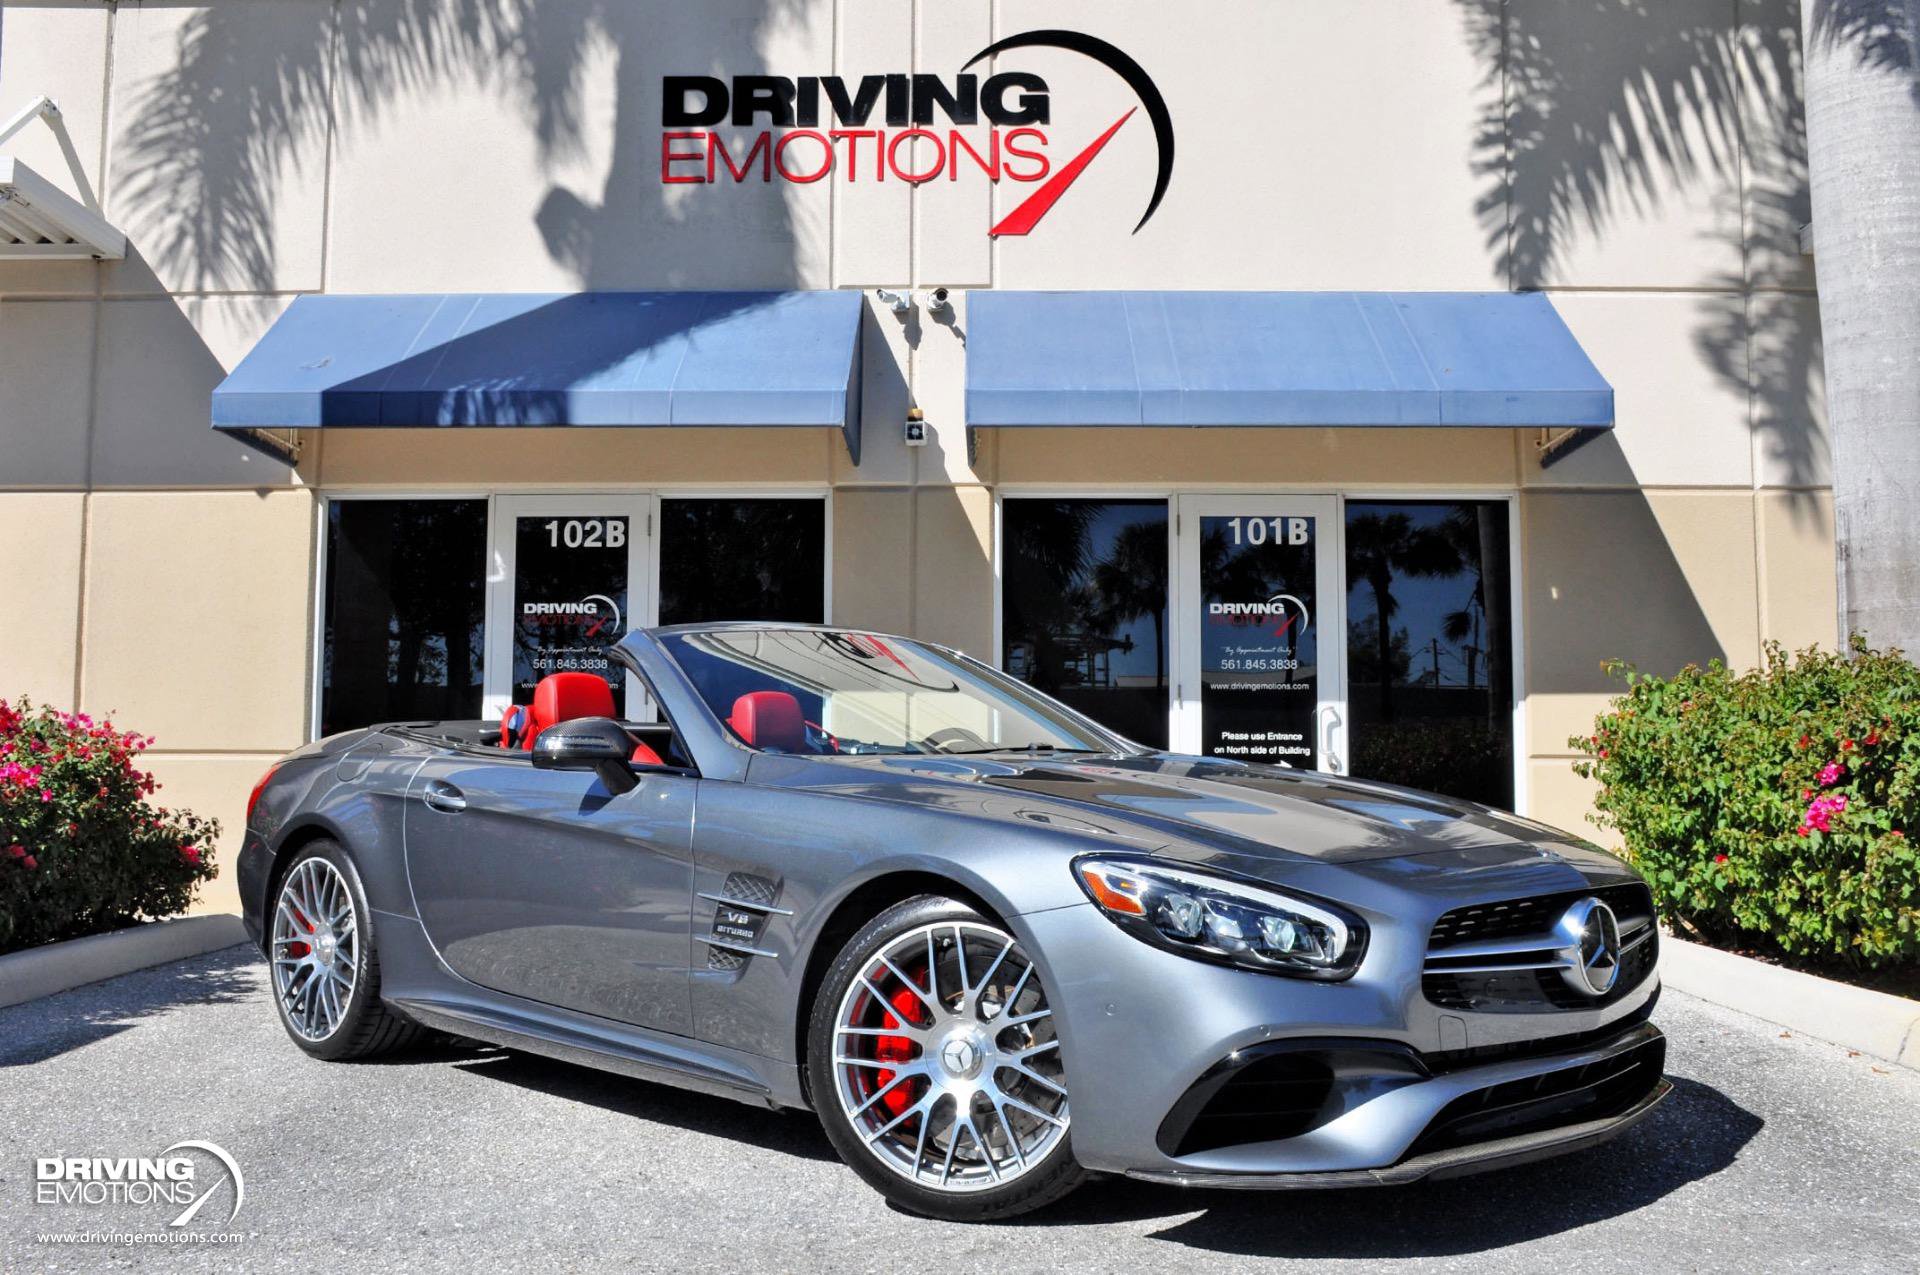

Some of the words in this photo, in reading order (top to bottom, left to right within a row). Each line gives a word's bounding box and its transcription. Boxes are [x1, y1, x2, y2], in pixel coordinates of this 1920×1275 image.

[662, 72, 1050, 127] DRIVING
[661, 128, 1050, 184] EMOTIONS
[545, 520, 625, 548] 102B
[1228, 517, 1308, 545] 101B
[523, 603, 598, 614] DRIVING
[1209, 603, 1285, 614] DRIVING
[533, 659, 608, 669] 561.845.3838
[1221, 659, 1298, 670] 561.845.3838
[1210, 683, 1310, 691] www.drivingemotions.com
[1221, 731, 1249, 741] Please
[1250, 733, 1266, 741] use
[1267, 731, 1303, 741] Entrance
[1214, 746, 1225, 754] on
[1226, 746, 1249, 754] North
[1250, 746, 1267, 754] side
[1268, 746, 1277, 754] of
[1278, 746, 1311, 757] Building
[728, 911, 749, 925] V8
